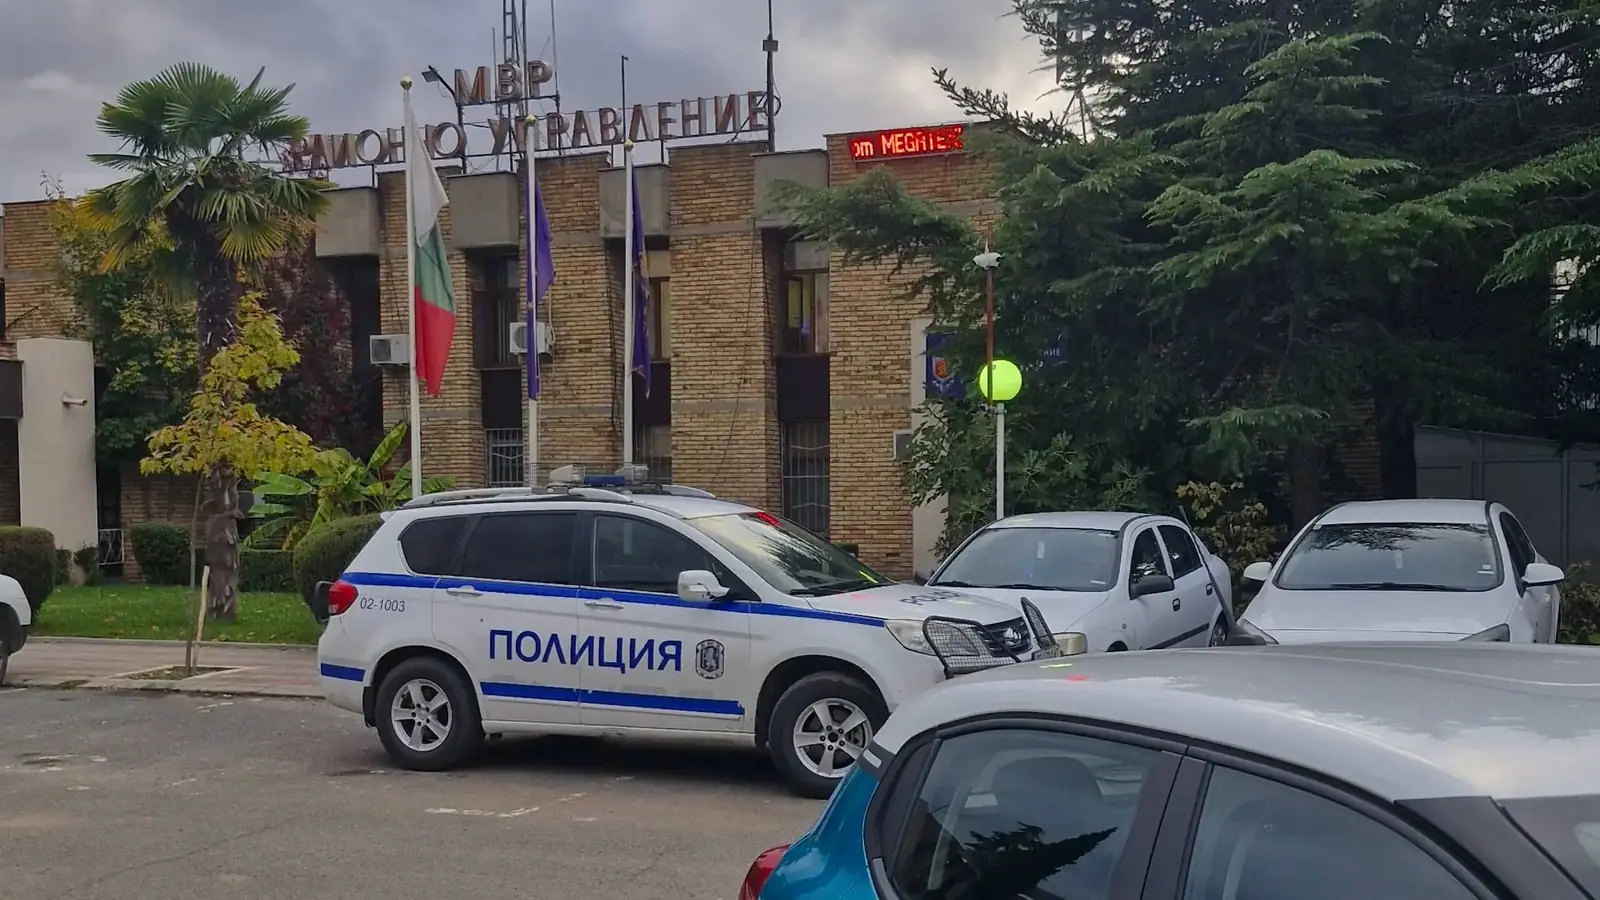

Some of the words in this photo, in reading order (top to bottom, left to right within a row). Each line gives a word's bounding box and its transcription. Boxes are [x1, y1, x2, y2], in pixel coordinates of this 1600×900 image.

[454, 60, 553, 104] МВР
[360, 597, 405, 612] 02-1003
[489, 629, 682, 674] ПОЛИЦИЯ
